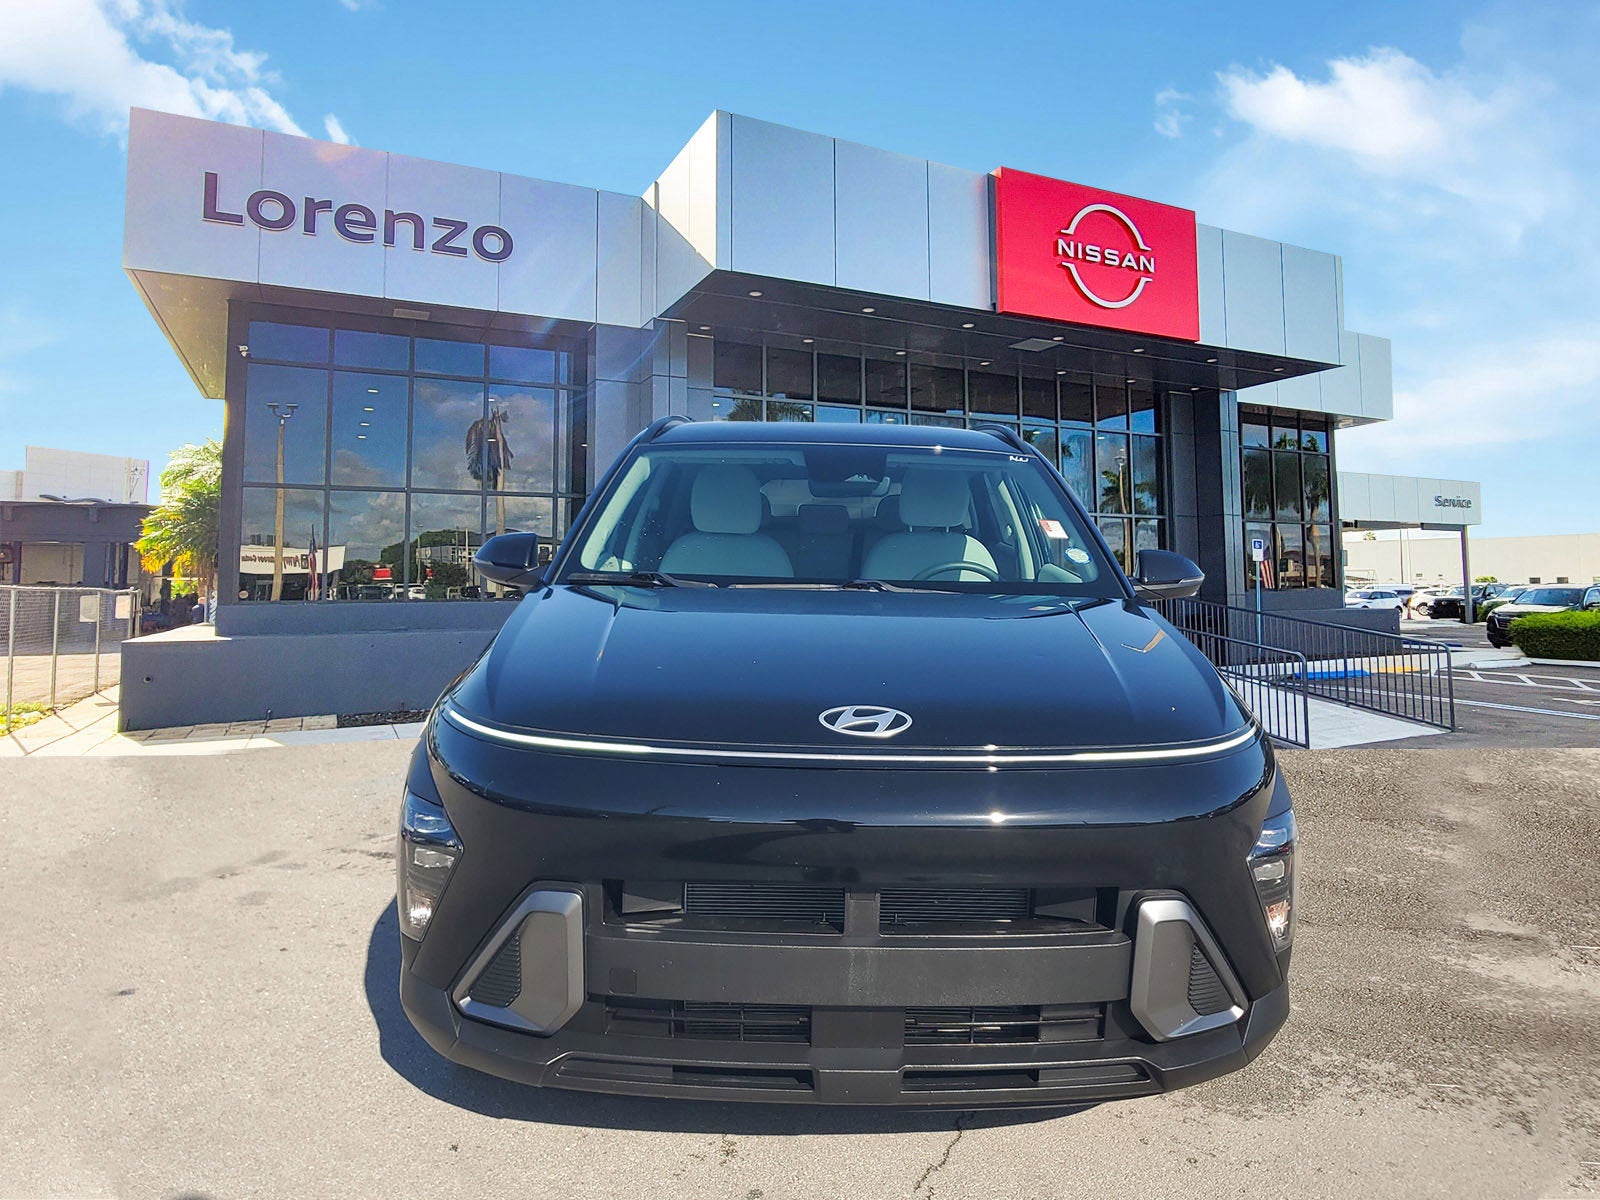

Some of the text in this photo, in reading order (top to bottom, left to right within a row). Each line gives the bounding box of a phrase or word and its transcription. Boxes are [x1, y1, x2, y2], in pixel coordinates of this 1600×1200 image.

[203, 171, 514, 262] Lorenzo
[1057, 238, 1155, 273] NISSAN
[1434, 495, 1472, 509] Service
